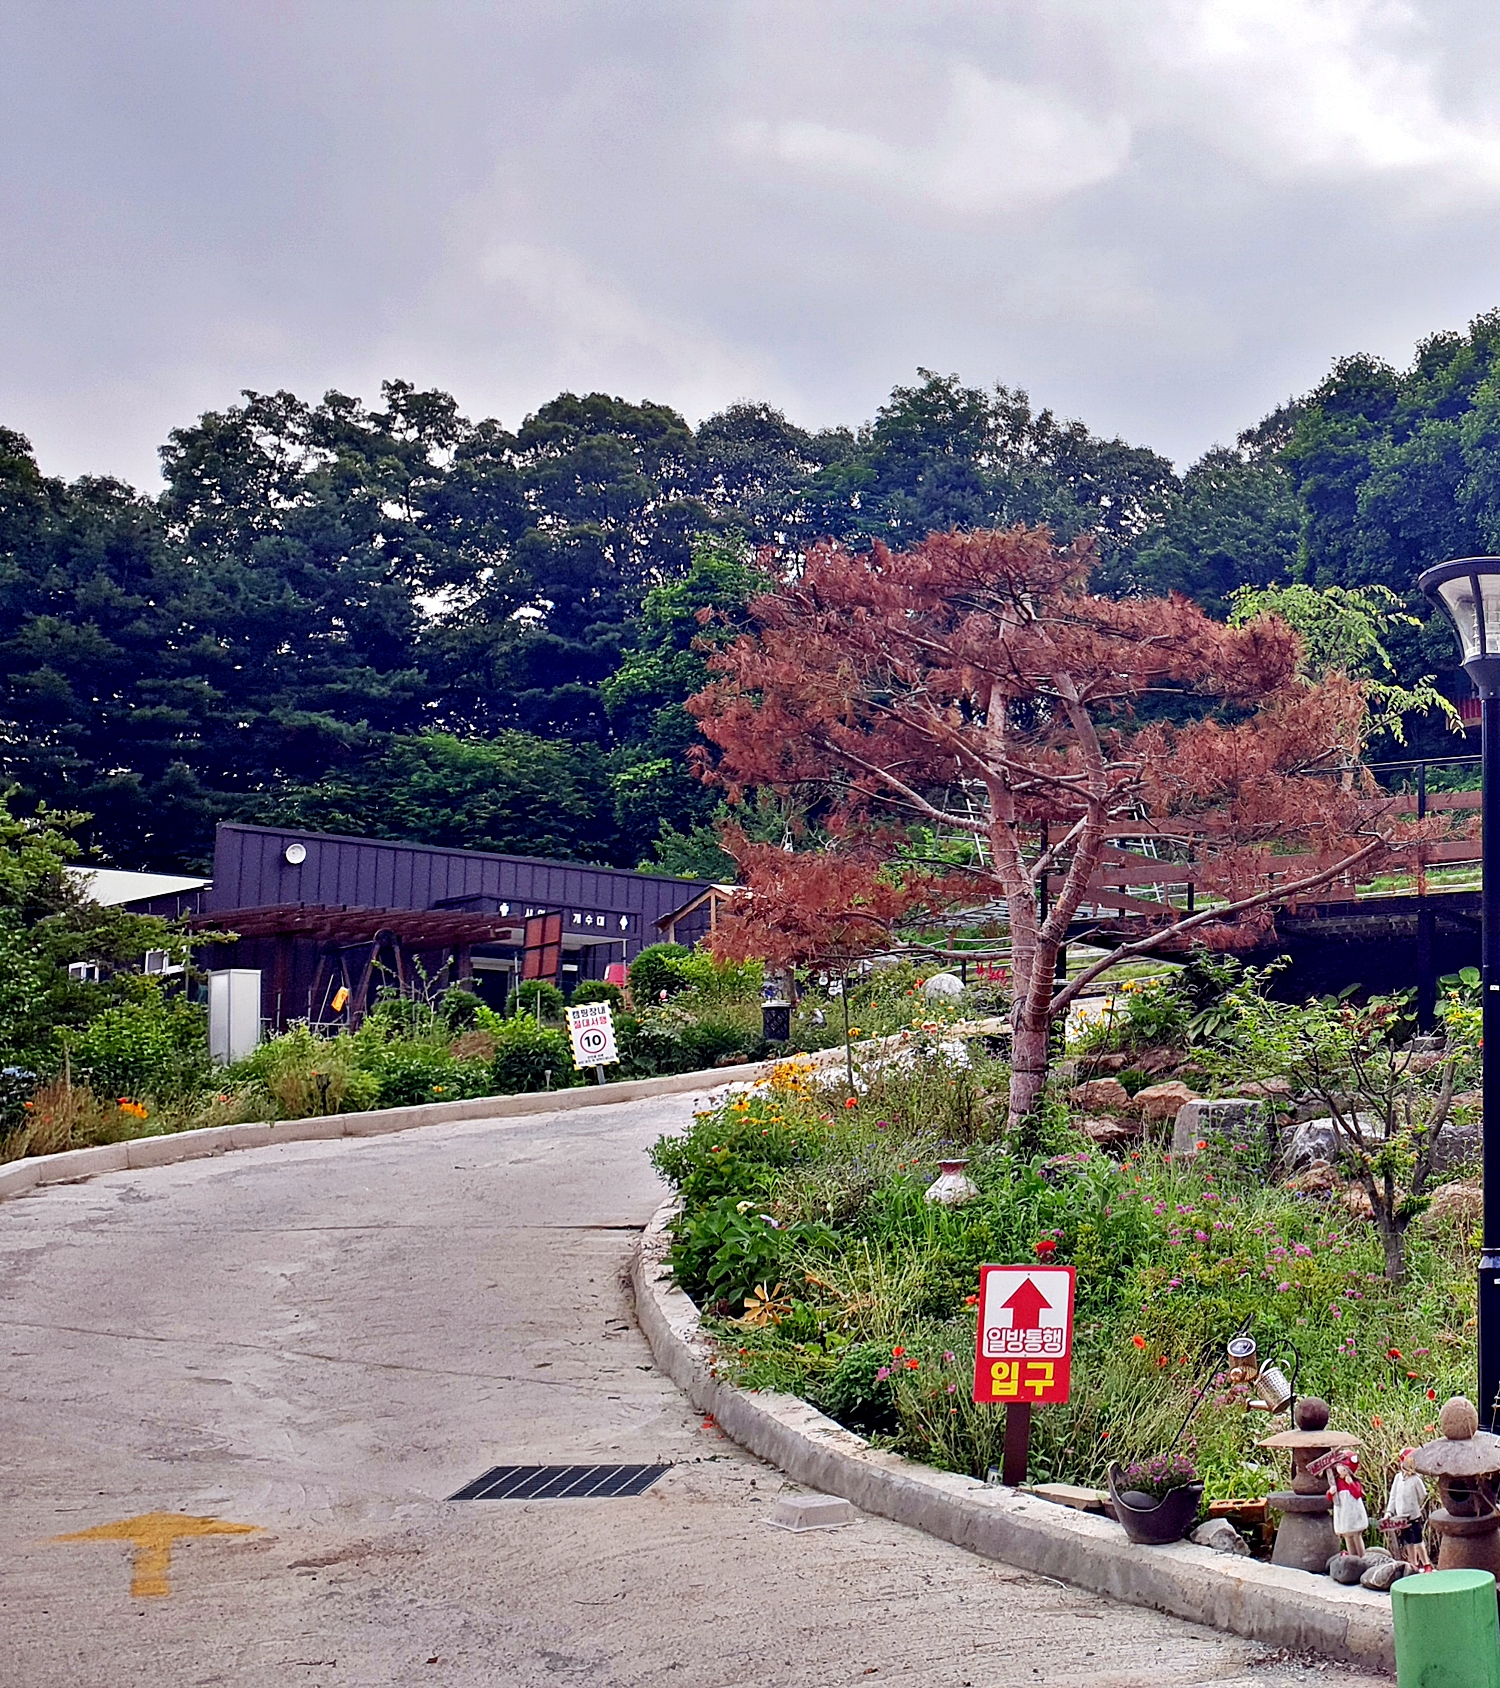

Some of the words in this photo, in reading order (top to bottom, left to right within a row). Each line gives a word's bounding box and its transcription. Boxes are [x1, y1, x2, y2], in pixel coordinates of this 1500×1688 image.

[584, 1035, 602, 1047] 10
[987, 1327, 1063, 1353] 일방통행
[990, 1361, 1055, 1396] 입구
